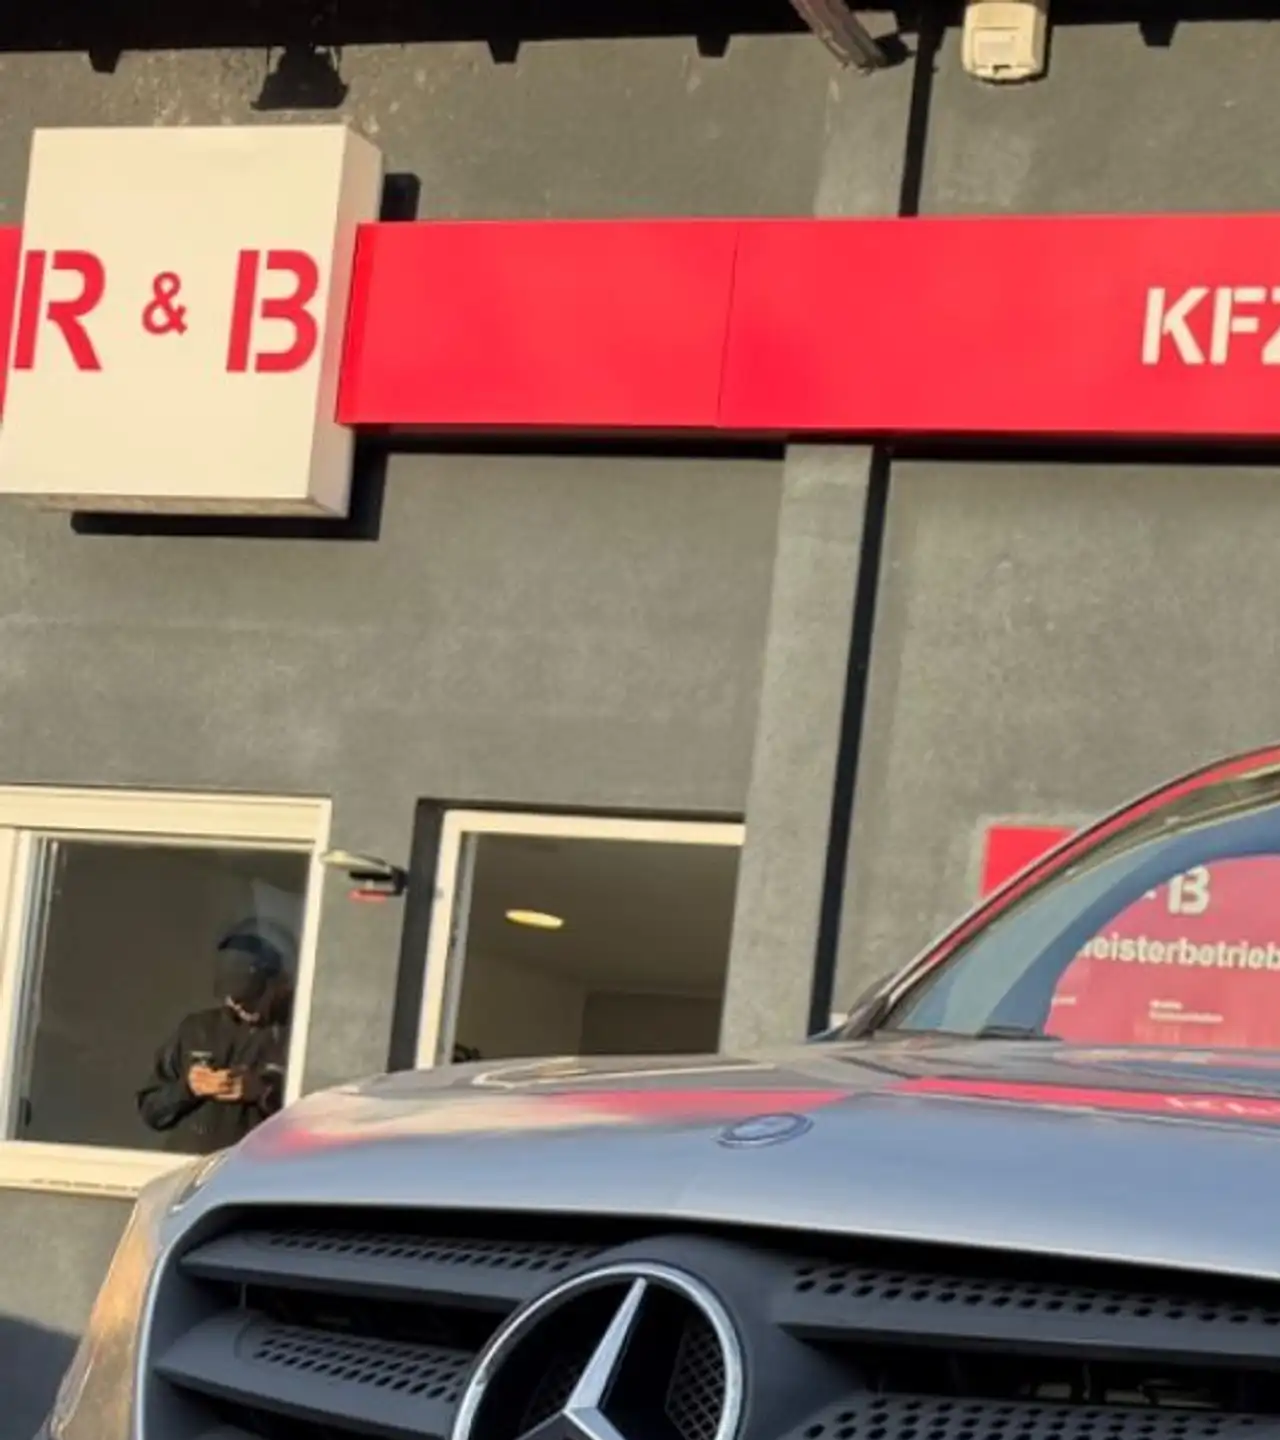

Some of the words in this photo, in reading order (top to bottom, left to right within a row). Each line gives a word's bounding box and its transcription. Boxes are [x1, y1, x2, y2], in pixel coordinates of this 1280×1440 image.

[13, 249, 106, 372] R
[142, 270, 189, 336] &
[225, 248, 320, 374] B
